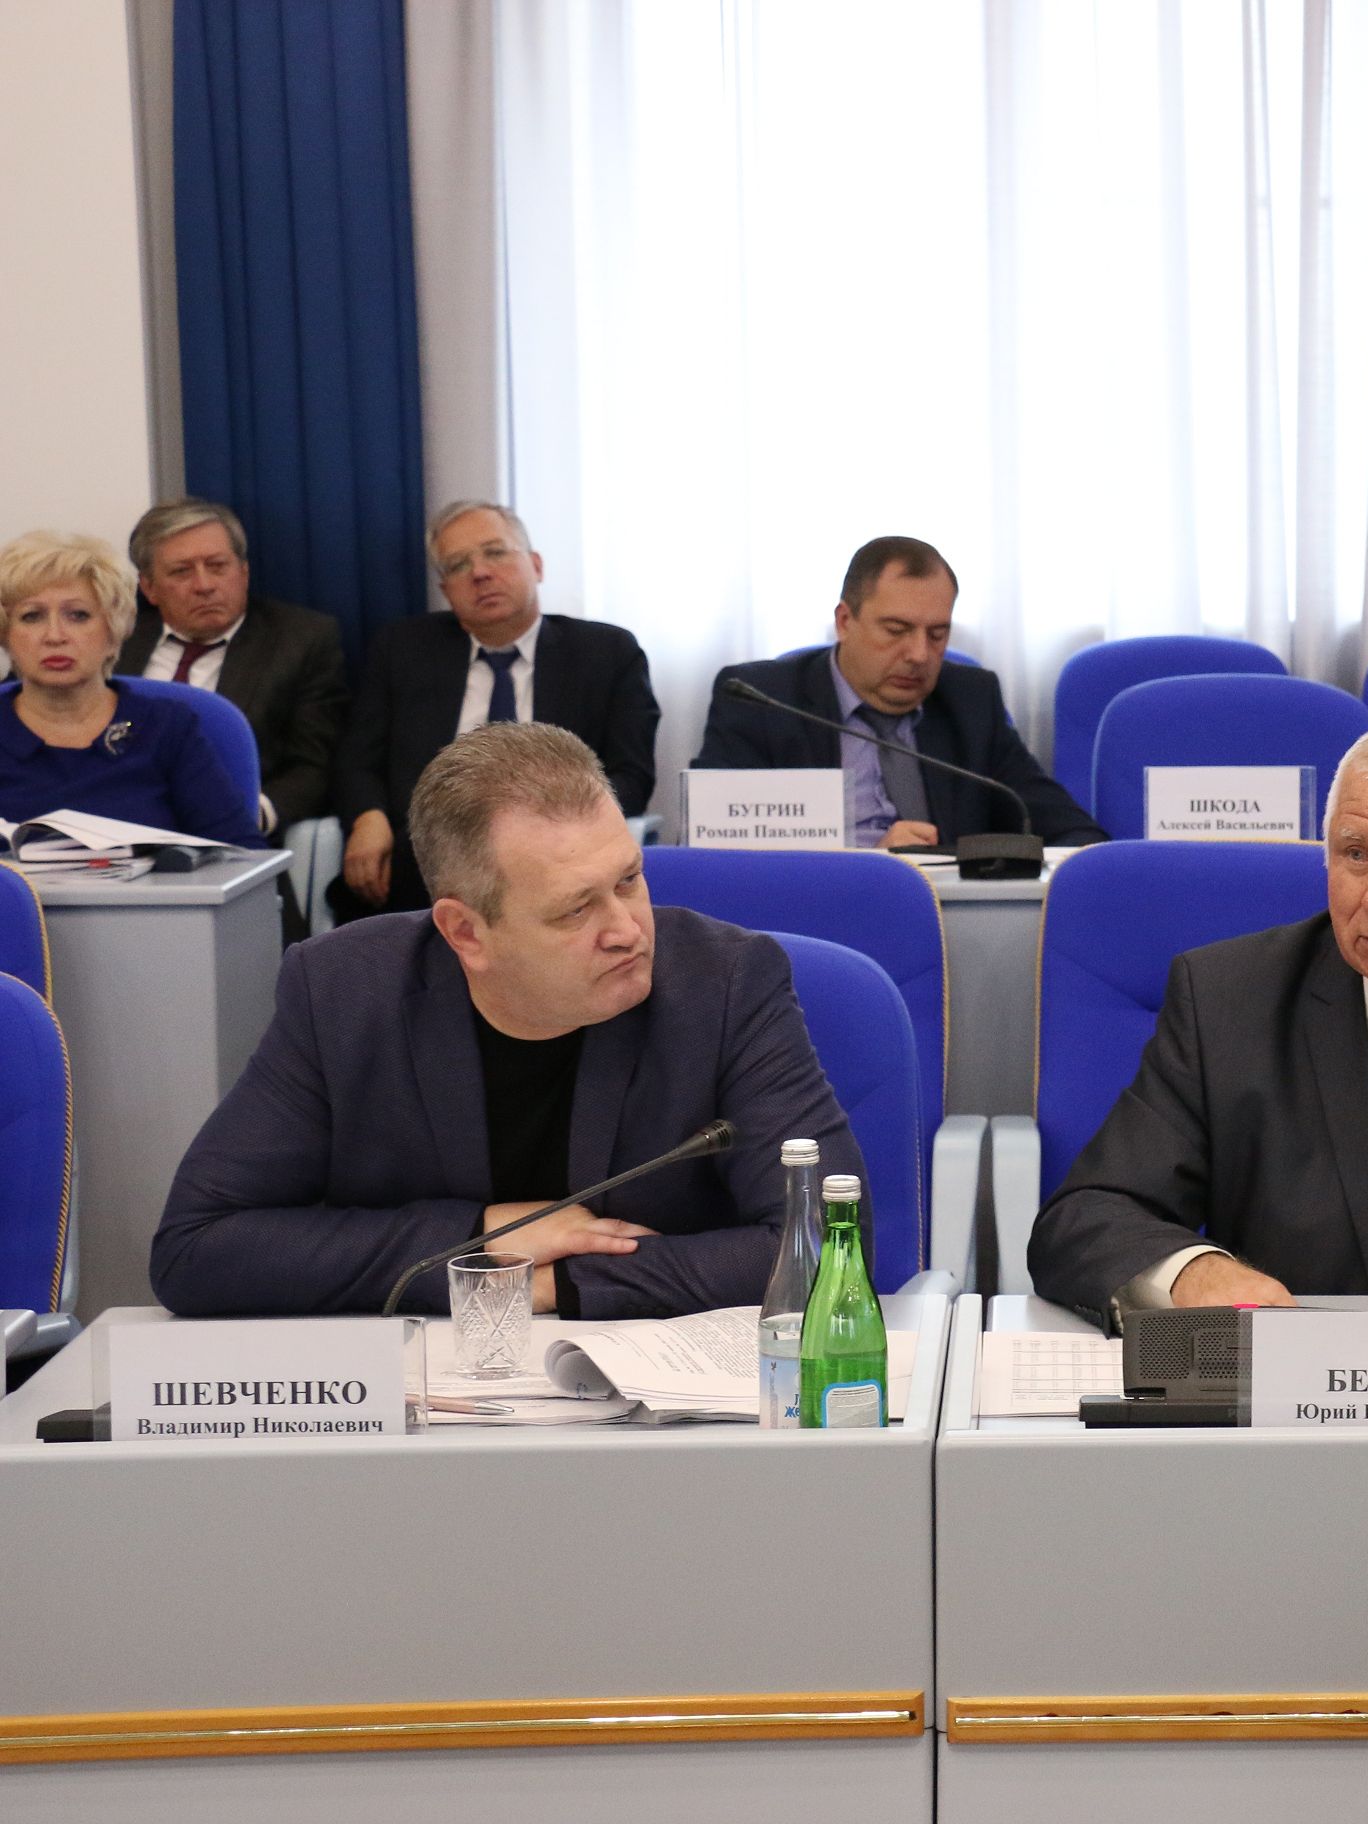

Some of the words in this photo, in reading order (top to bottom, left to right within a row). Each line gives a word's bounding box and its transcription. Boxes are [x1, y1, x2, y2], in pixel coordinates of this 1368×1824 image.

[728, 802, 806, 818] БУГРИН
[1189, 799, 1262, 815] ШКОДА
[695, 824, 749, 839] Роман
[754, 824, 838, 839] Павлович
[1157, 819, 1212, 831] Алексей
[1215, 819, 1294, 831] Васильевич
[152, 1380, 368, 1407] ШЕВЧЕНКО
[1296, 1403, 1357, 1424] Юрий
[137, 1417, 246, 1438] Владимир
[252, 1416, 384, 1435] Николаевич
